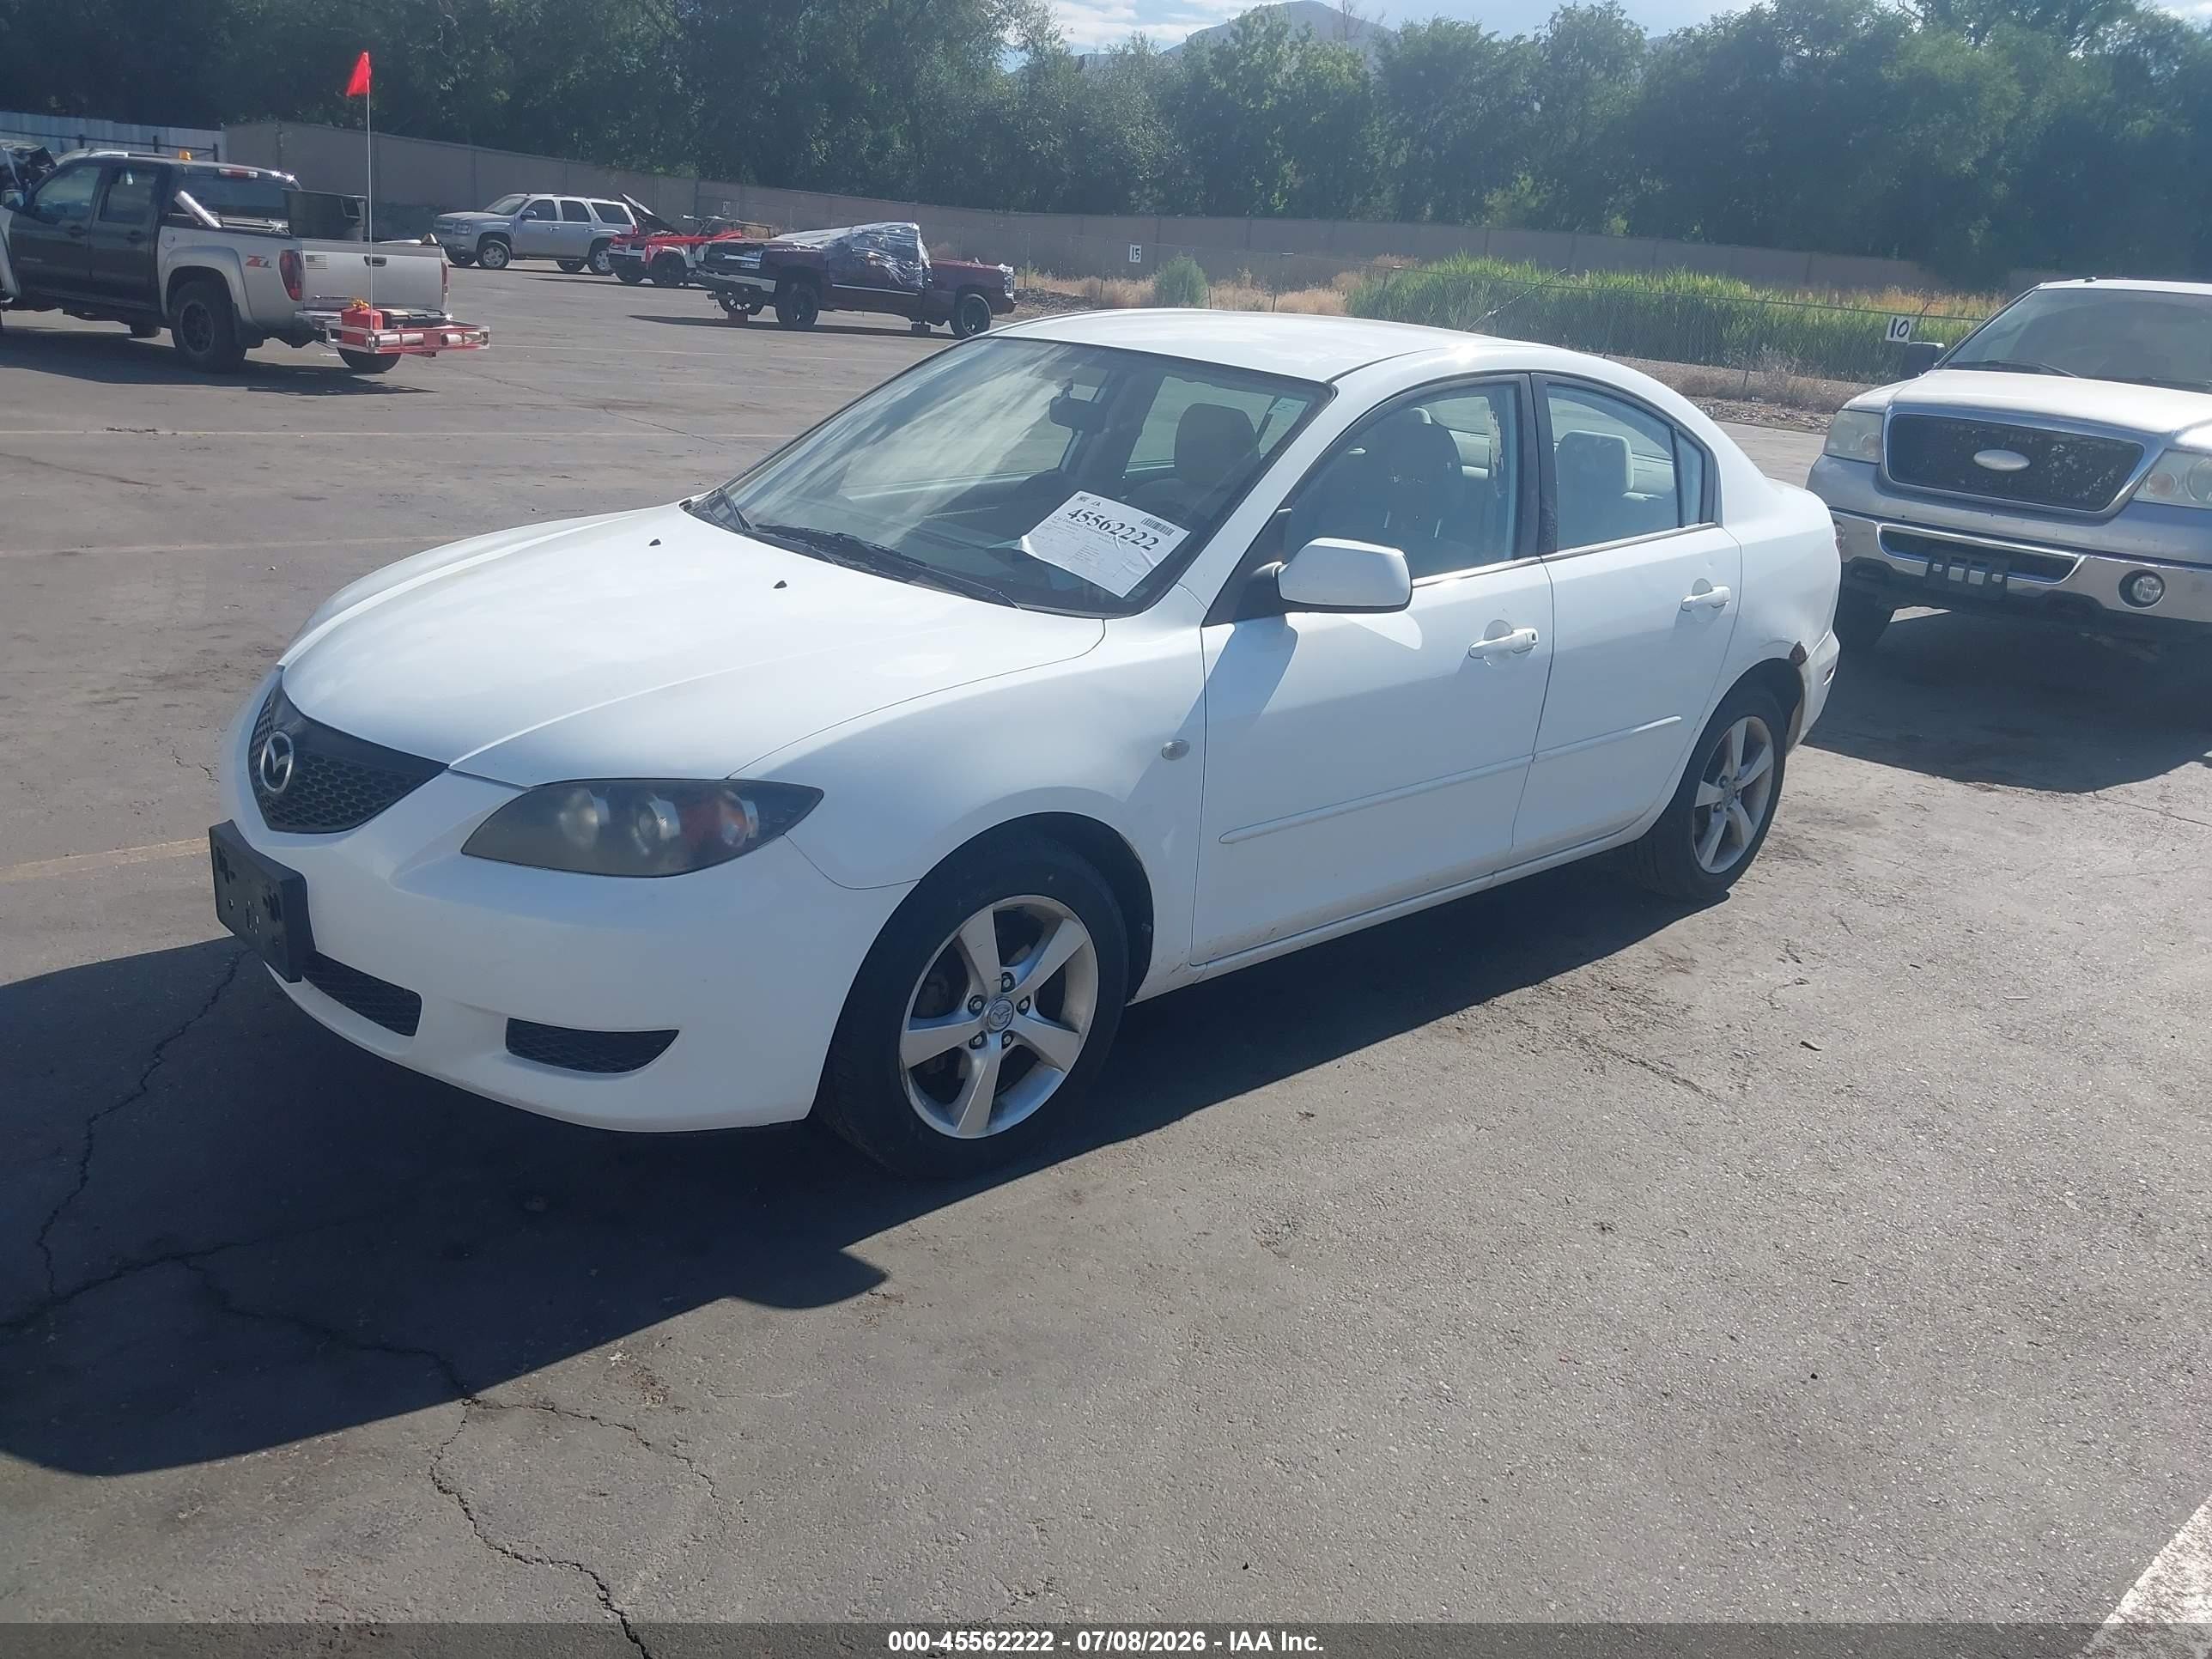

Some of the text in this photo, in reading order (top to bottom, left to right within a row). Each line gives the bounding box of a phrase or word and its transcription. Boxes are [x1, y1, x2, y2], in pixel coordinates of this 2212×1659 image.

[1132, 246, 1140, 260] 15
[1890, 317, 1910, 338] 10
[1067, 508, 1159, 550] 45562222
